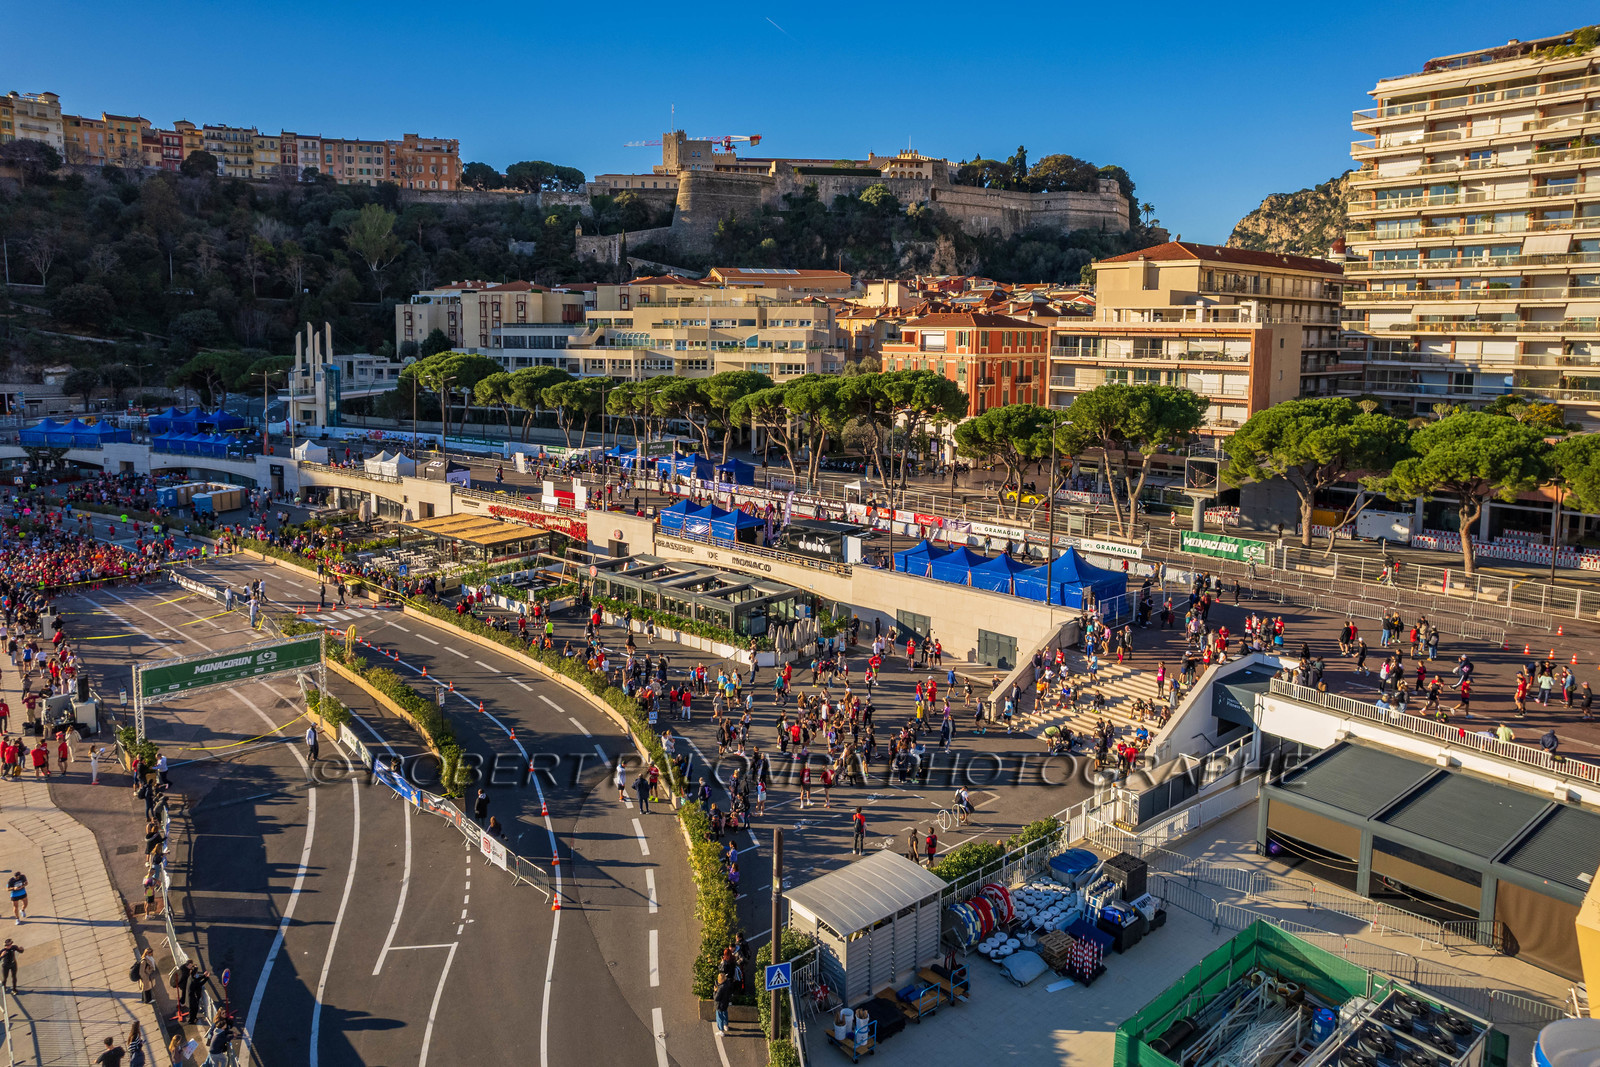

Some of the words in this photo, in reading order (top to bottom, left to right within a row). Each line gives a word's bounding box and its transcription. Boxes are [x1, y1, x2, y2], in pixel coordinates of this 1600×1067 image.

[984, 526, 1021, 537] GRAMAGLIA
[656, 539, 694, 555] BRASSERIE
[707, 551, 718, 560] DE
[732, 556, 771, 572] MONACO
[1095, 543, 1138, 555] GRAMAGLIA
[194, 655, 253, 675] MONACORUN
